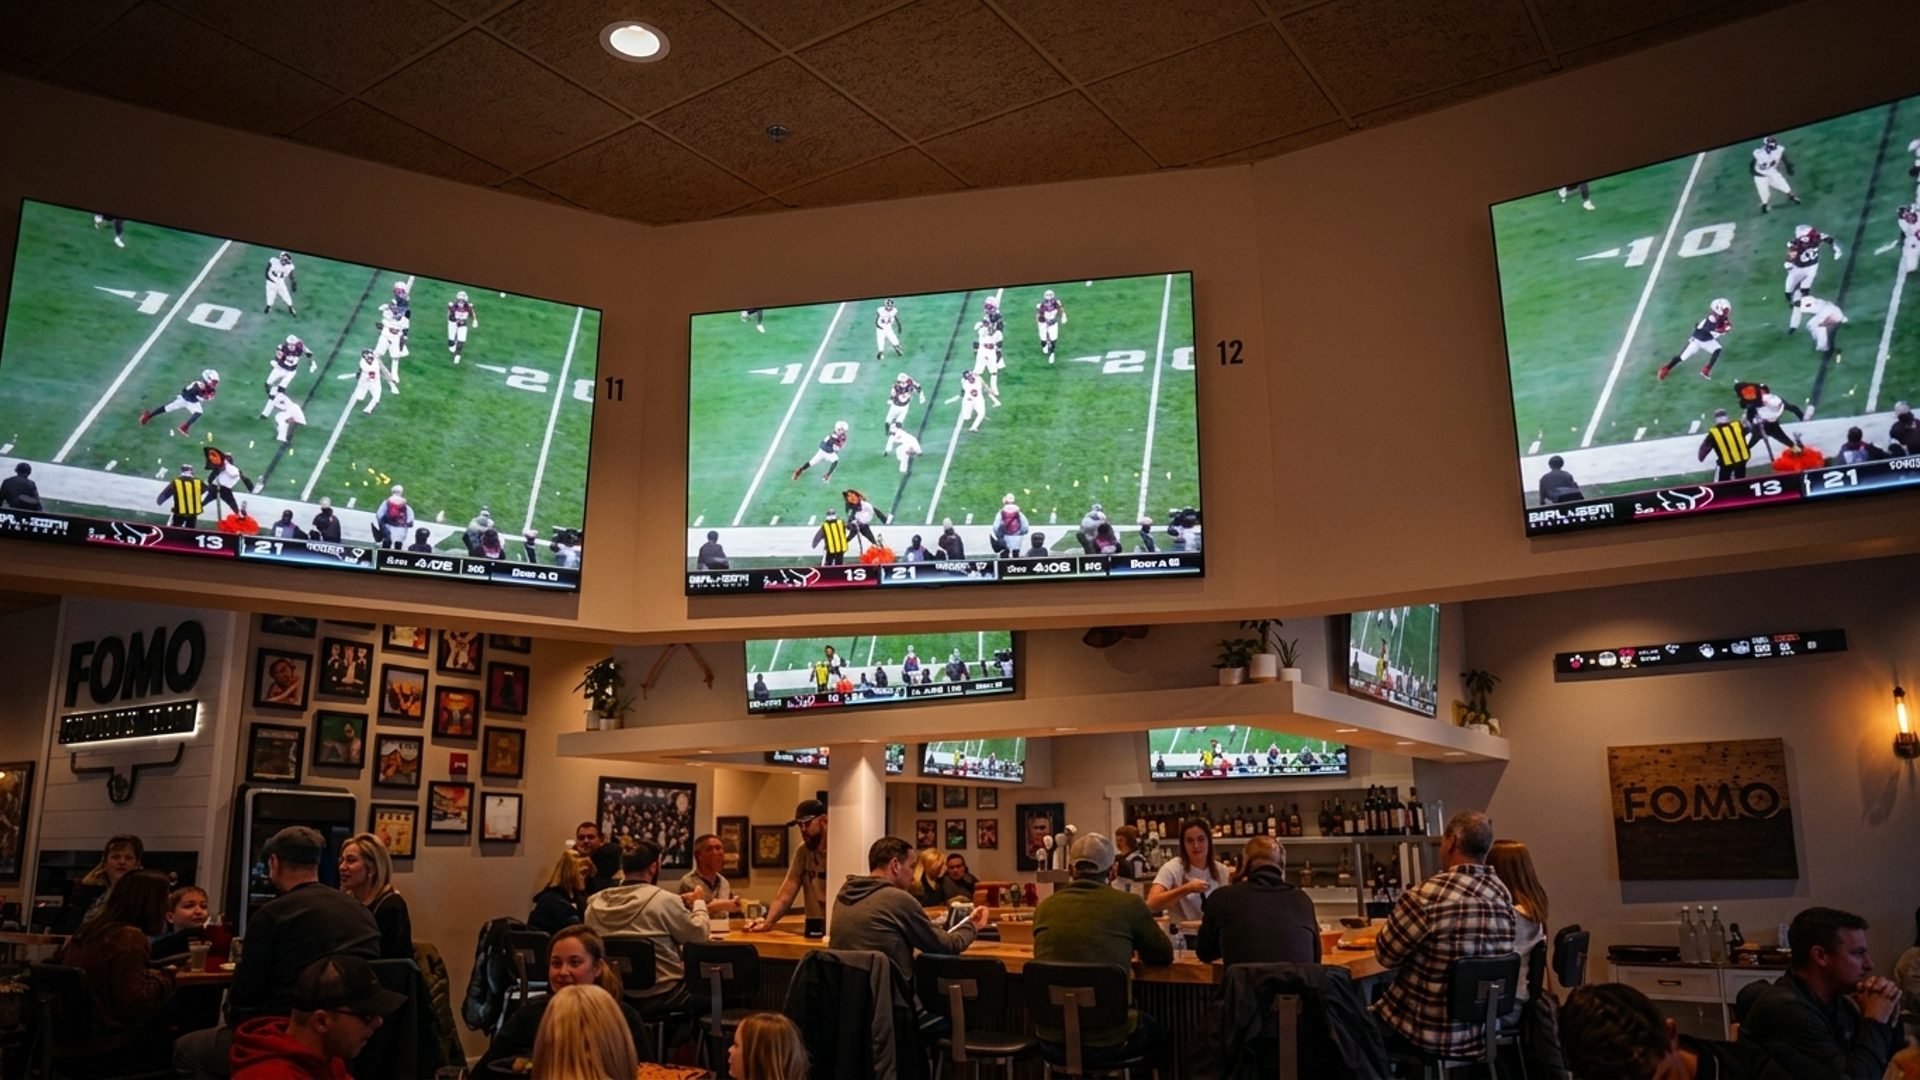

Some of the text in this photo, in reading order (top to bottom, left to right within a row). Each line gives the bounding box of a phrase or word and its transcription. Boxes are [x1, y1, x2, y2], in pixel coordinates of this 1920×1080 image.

[1217, 339, 1243, 365] 12
[605, 376, 624, 401] 11
[1750, 480, 1782, 497] 13
[1823, 469, 1858, 489] 21
[195, 534, 224, 549] 13
[254, 540, 283, 555] 21
[892, 566, 917, 580] 21
[64, 620, 206, 708] FOMO
[1623, 782, 1781, 823] FOMO
